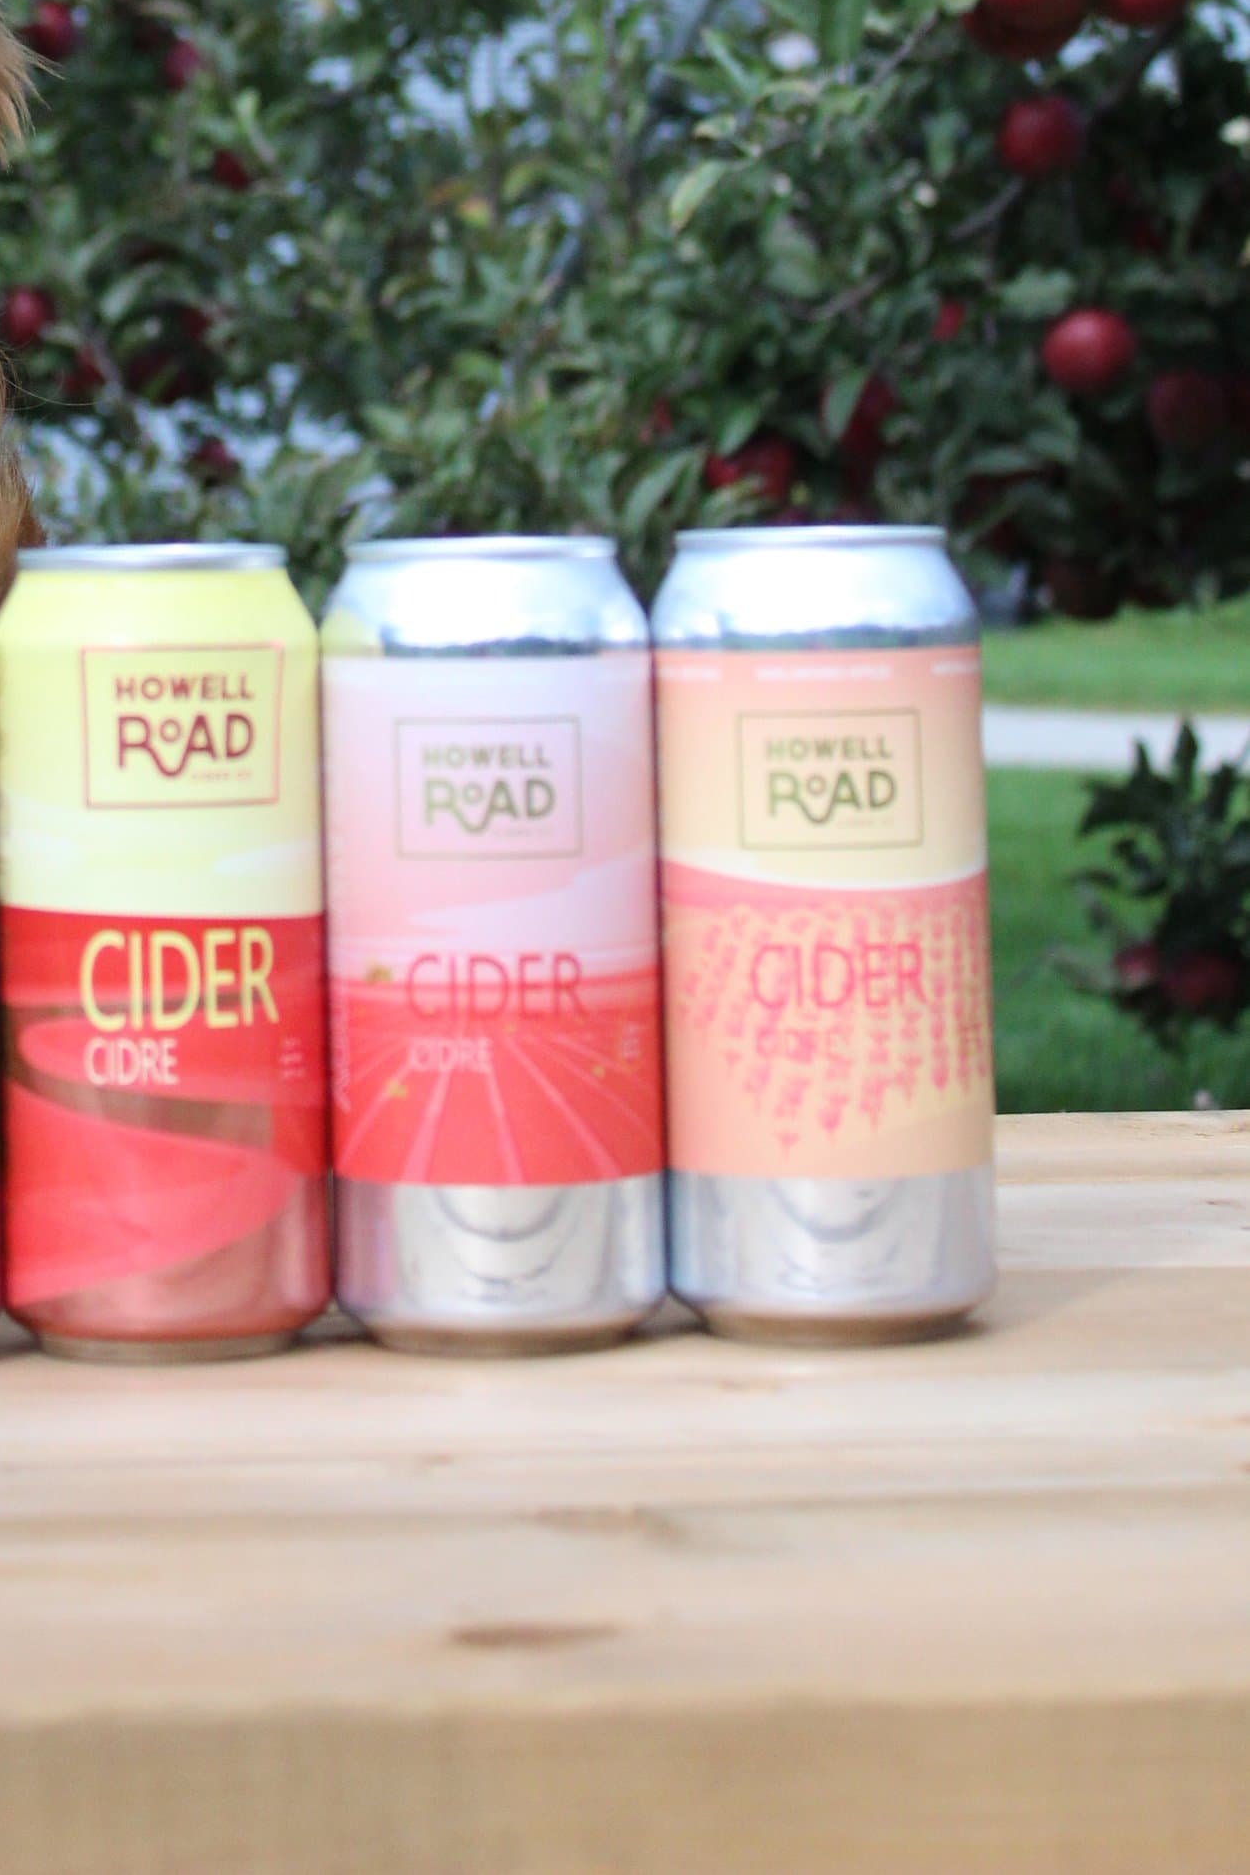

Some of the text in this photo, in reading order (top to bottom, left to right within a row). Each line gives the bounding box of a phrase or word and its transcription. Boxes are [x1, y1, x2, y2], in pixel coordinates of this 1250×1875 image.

[114, 672, 254, 702] HOWELL
[117, 711, 255, 778] ROAD
[422, 742, 553, 770] HOWELL
[765, 735, 894, 761] HOWELL
[423, 777, 557, 835] ROAD
[767, 770, 897, 825] ROAD
[80, 927, 279, 1031] CIDER
[407, 952, 589, 1021] CIDER
[750, 943, 928, 1009] CIDER
[84, 1036, 179, 1086] CIDRE
[408, 1036, 494, 1073] CIDRE
